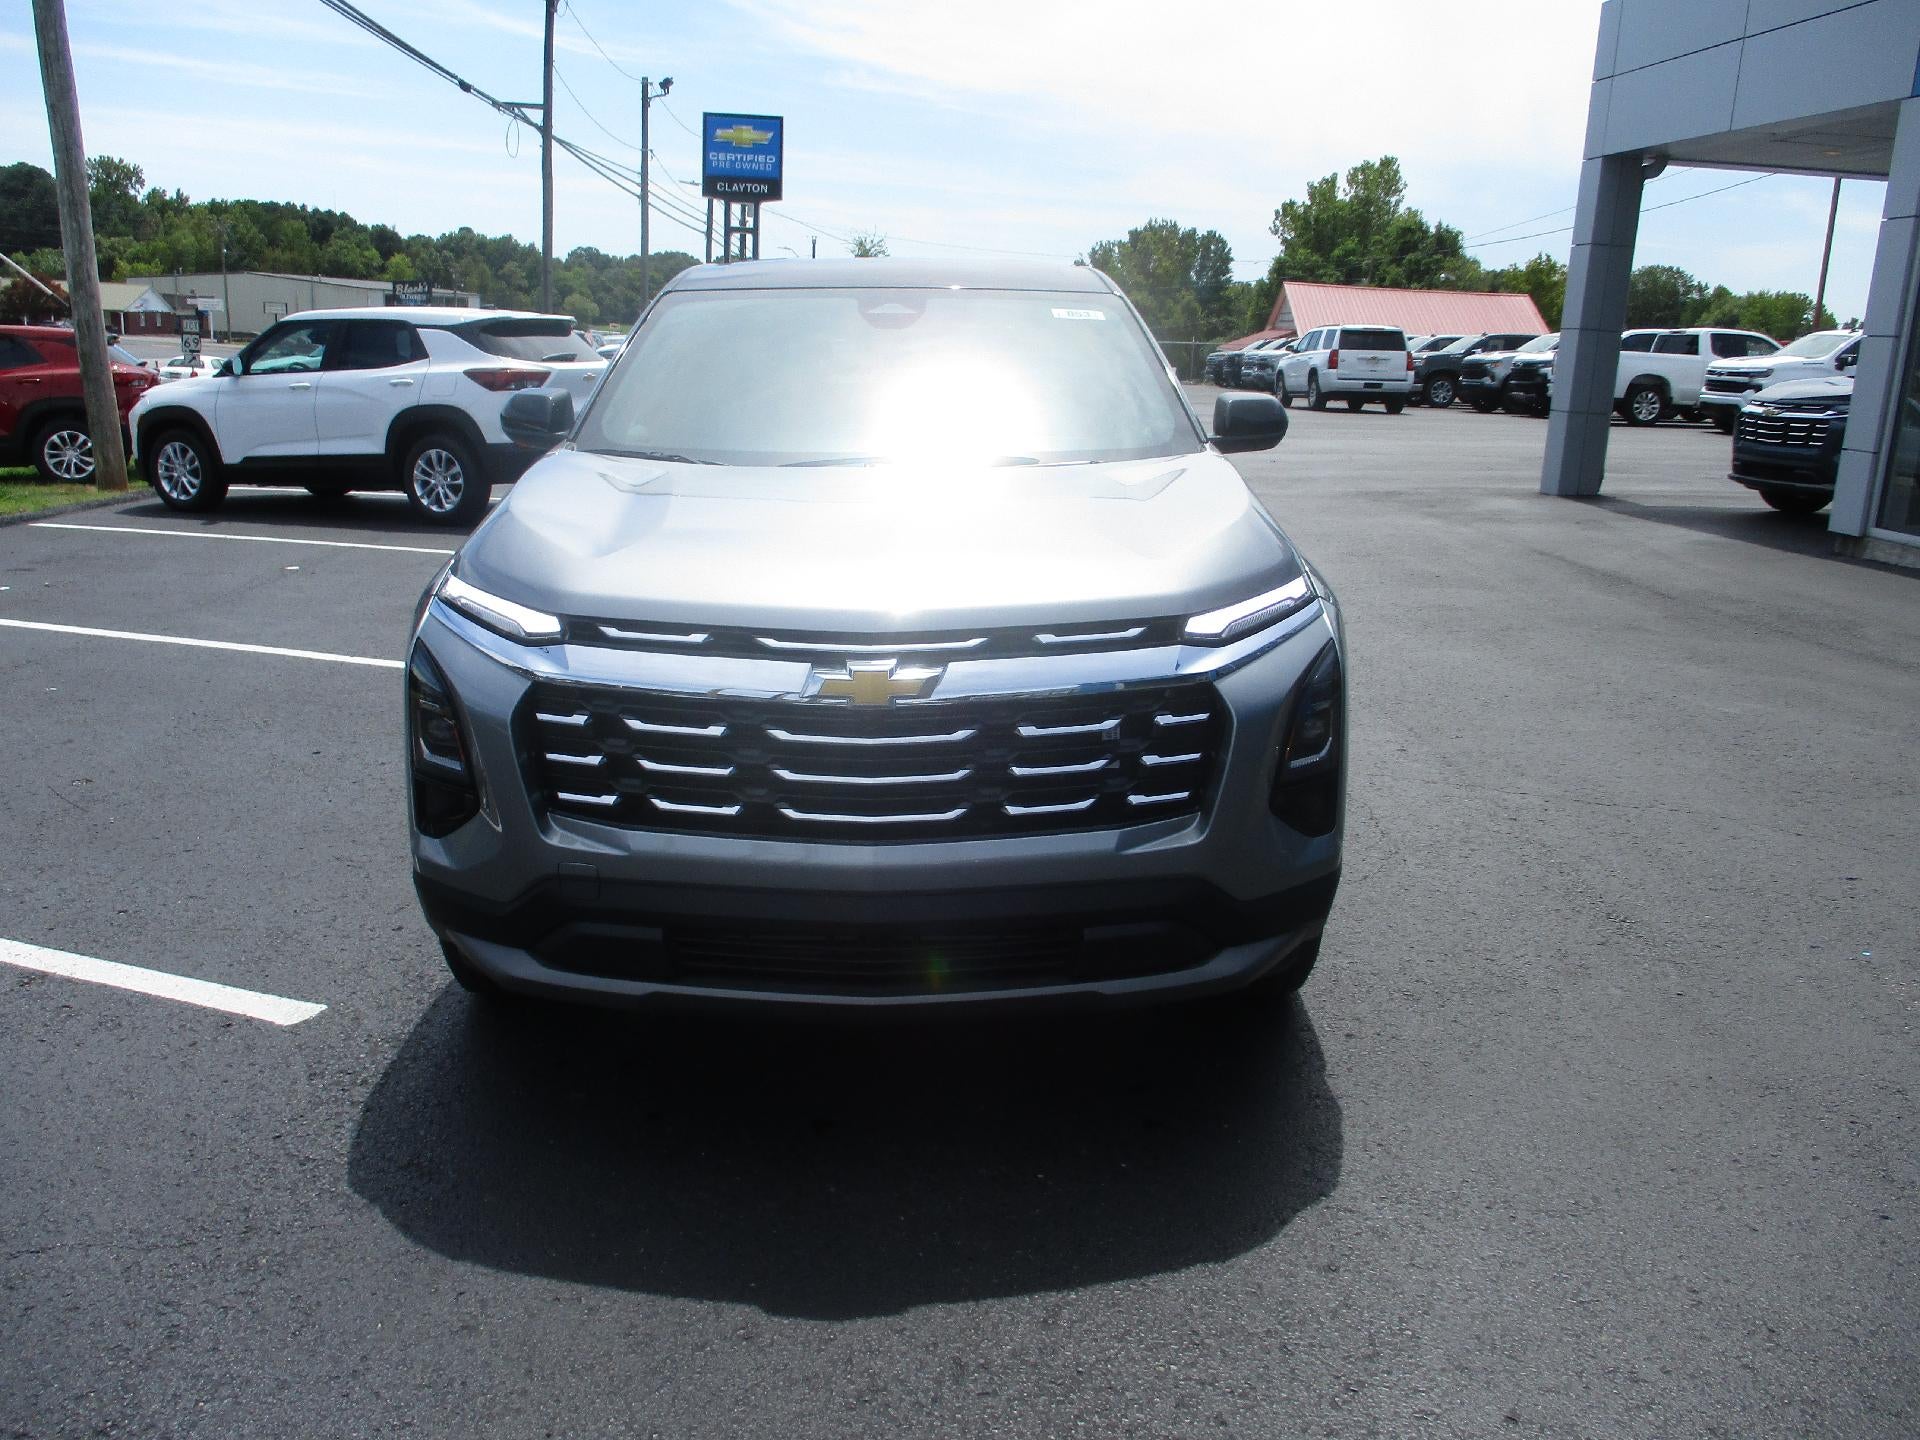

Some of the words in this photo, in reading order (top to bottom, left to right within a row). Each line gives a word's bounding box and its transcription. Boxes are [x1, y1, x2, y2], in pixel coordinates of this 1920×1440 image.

[709, 152, 776, 163] CERTIFIED
[717, 182, 768, 193] CLAYTON
[183, 337, 199, 348] 69
